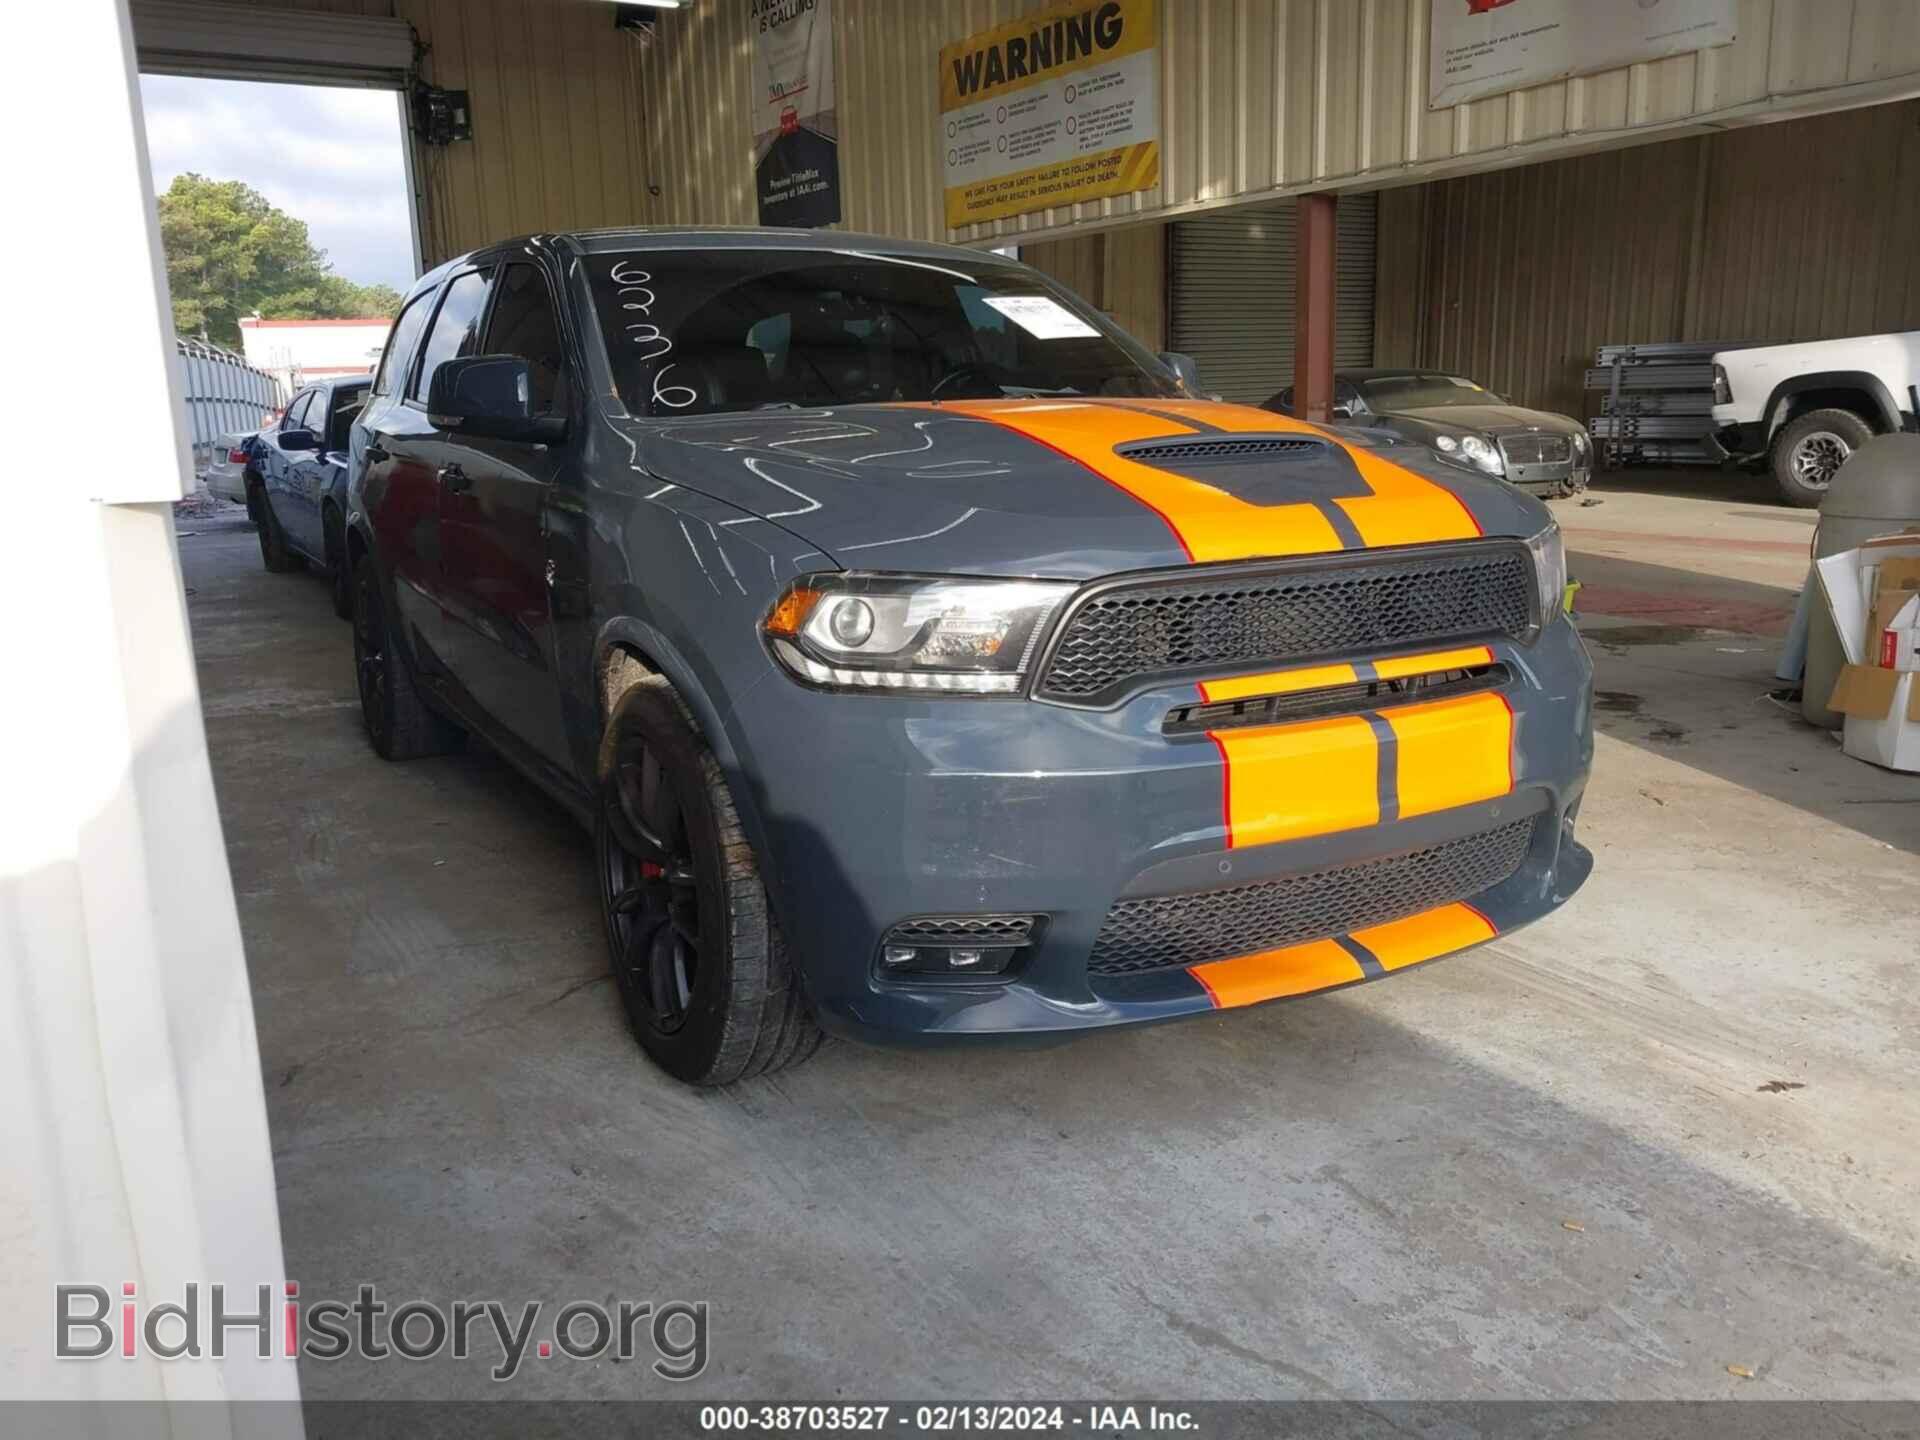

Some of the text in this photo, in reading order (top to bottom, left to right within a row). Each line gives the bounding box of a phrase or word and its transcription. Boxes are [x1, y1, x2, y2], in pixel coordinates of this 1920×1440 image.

[769, 0, 814, 28] CALLING
[952, 2, 1123, 97] WARNING
[1071, 162, 1096, 175] FOLLOW
